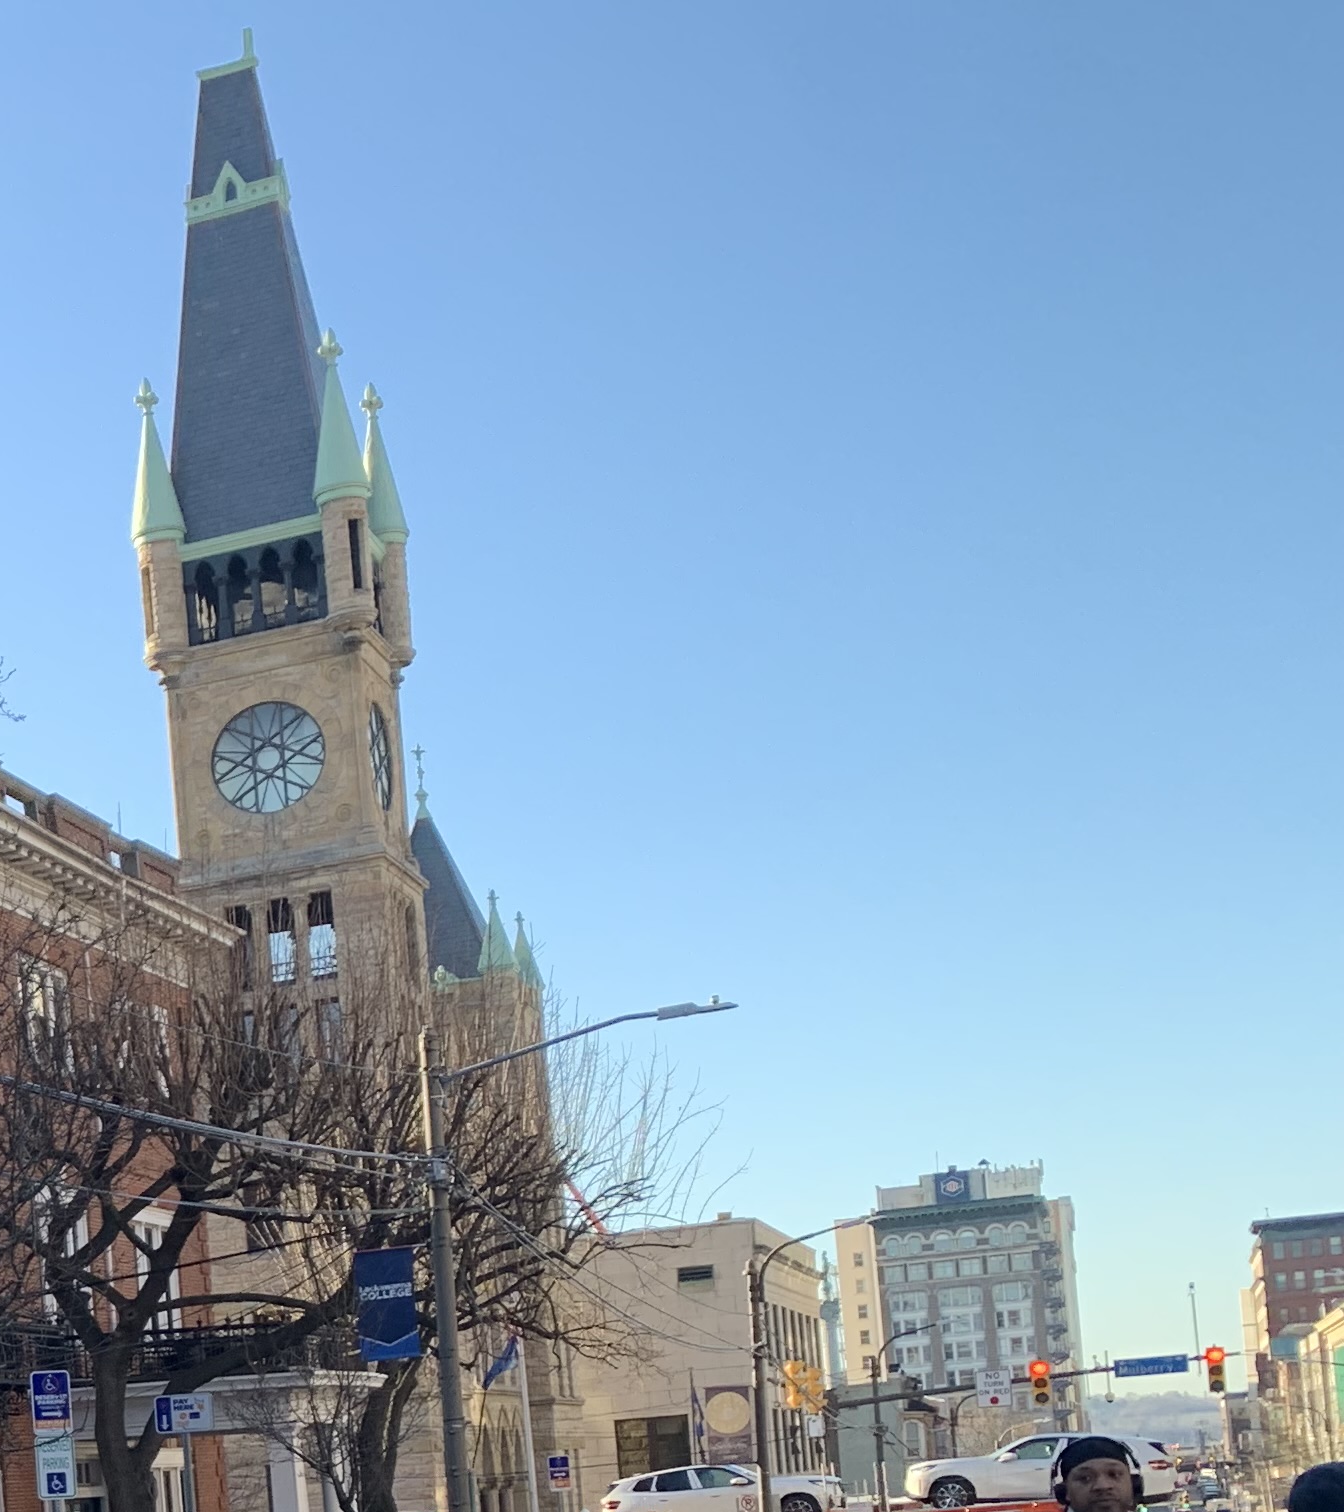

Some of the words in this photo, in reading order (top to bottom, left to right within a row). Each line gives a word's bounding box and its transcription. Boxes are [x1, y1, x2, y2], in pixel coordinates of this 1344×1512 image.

[359, 1288, 413, 1300] COLLEGE
[1119, 1364, 1174, 1376] Mulberry
[985, 1371, 1000, 1380] NO
[993, 1387, 1010, 1395] RED
[172, 1397, 189, 1405] PAY
[173, 1403, 195, 1411] HERE
